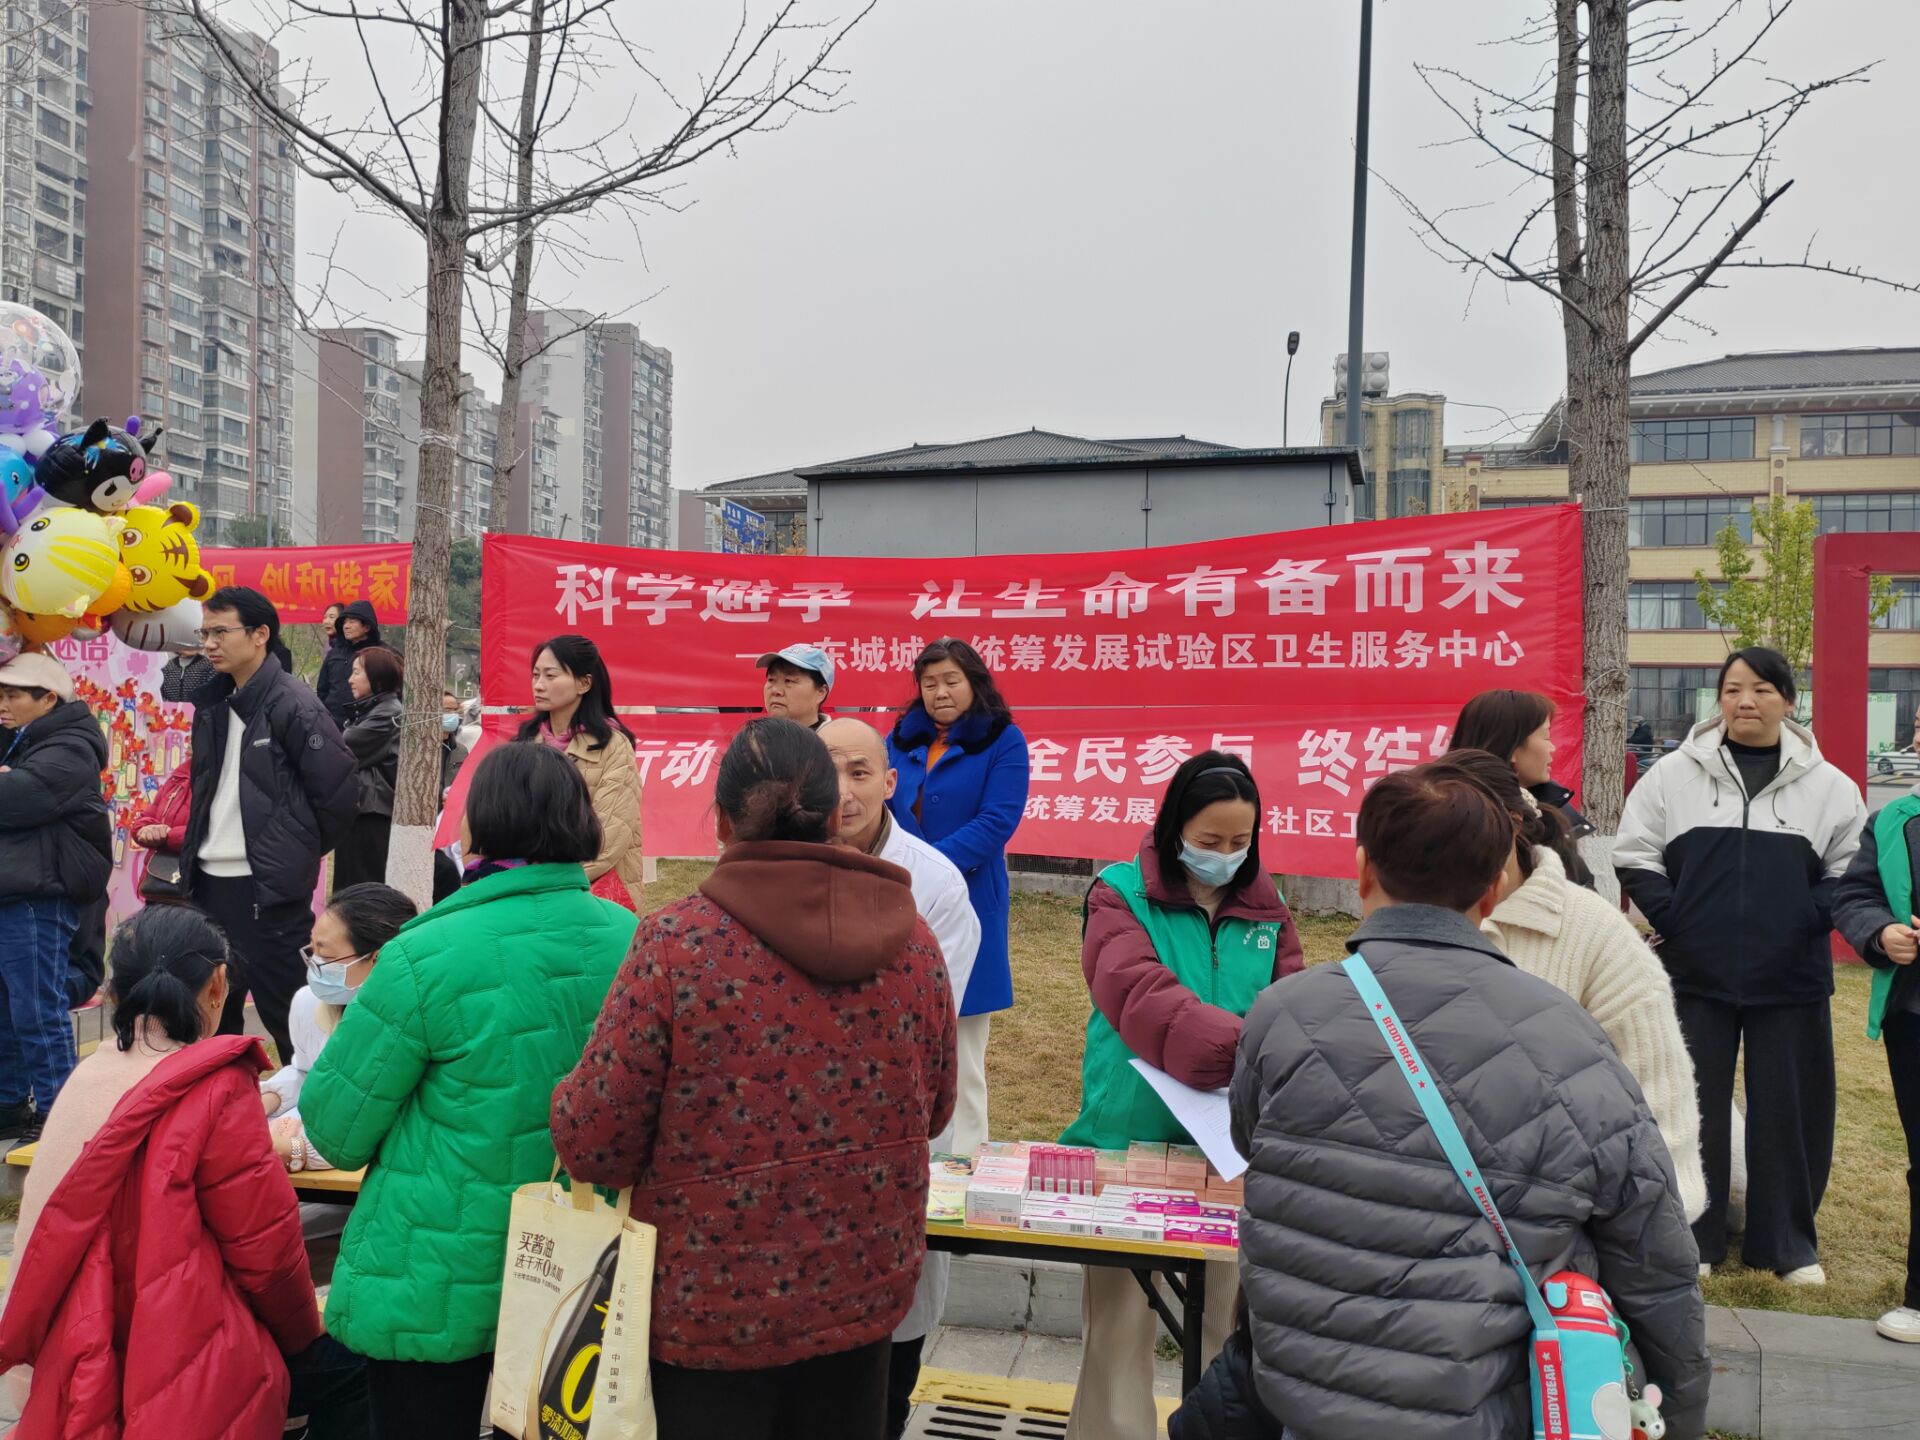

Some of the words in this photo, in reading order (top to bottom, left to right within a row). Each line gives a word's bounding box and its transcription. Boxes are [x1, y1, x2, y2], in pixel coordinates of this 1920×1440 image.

[260, 560, 411, 610] 创和谐家
[554, 564, 854, 626] 科学避孕
[908, 541, 1525, 620] 让生命有备而来
[1297, 725, 1452, 797] 终结
[1022, 794, 1157, 826] 统筹发展
[1382, 1016, 1419, 1075] BEDDYBEAR
[517, 1231, 555, 1259] 买酱油
[1543, 1363, 1563, 1435] BEDDYBEAR
